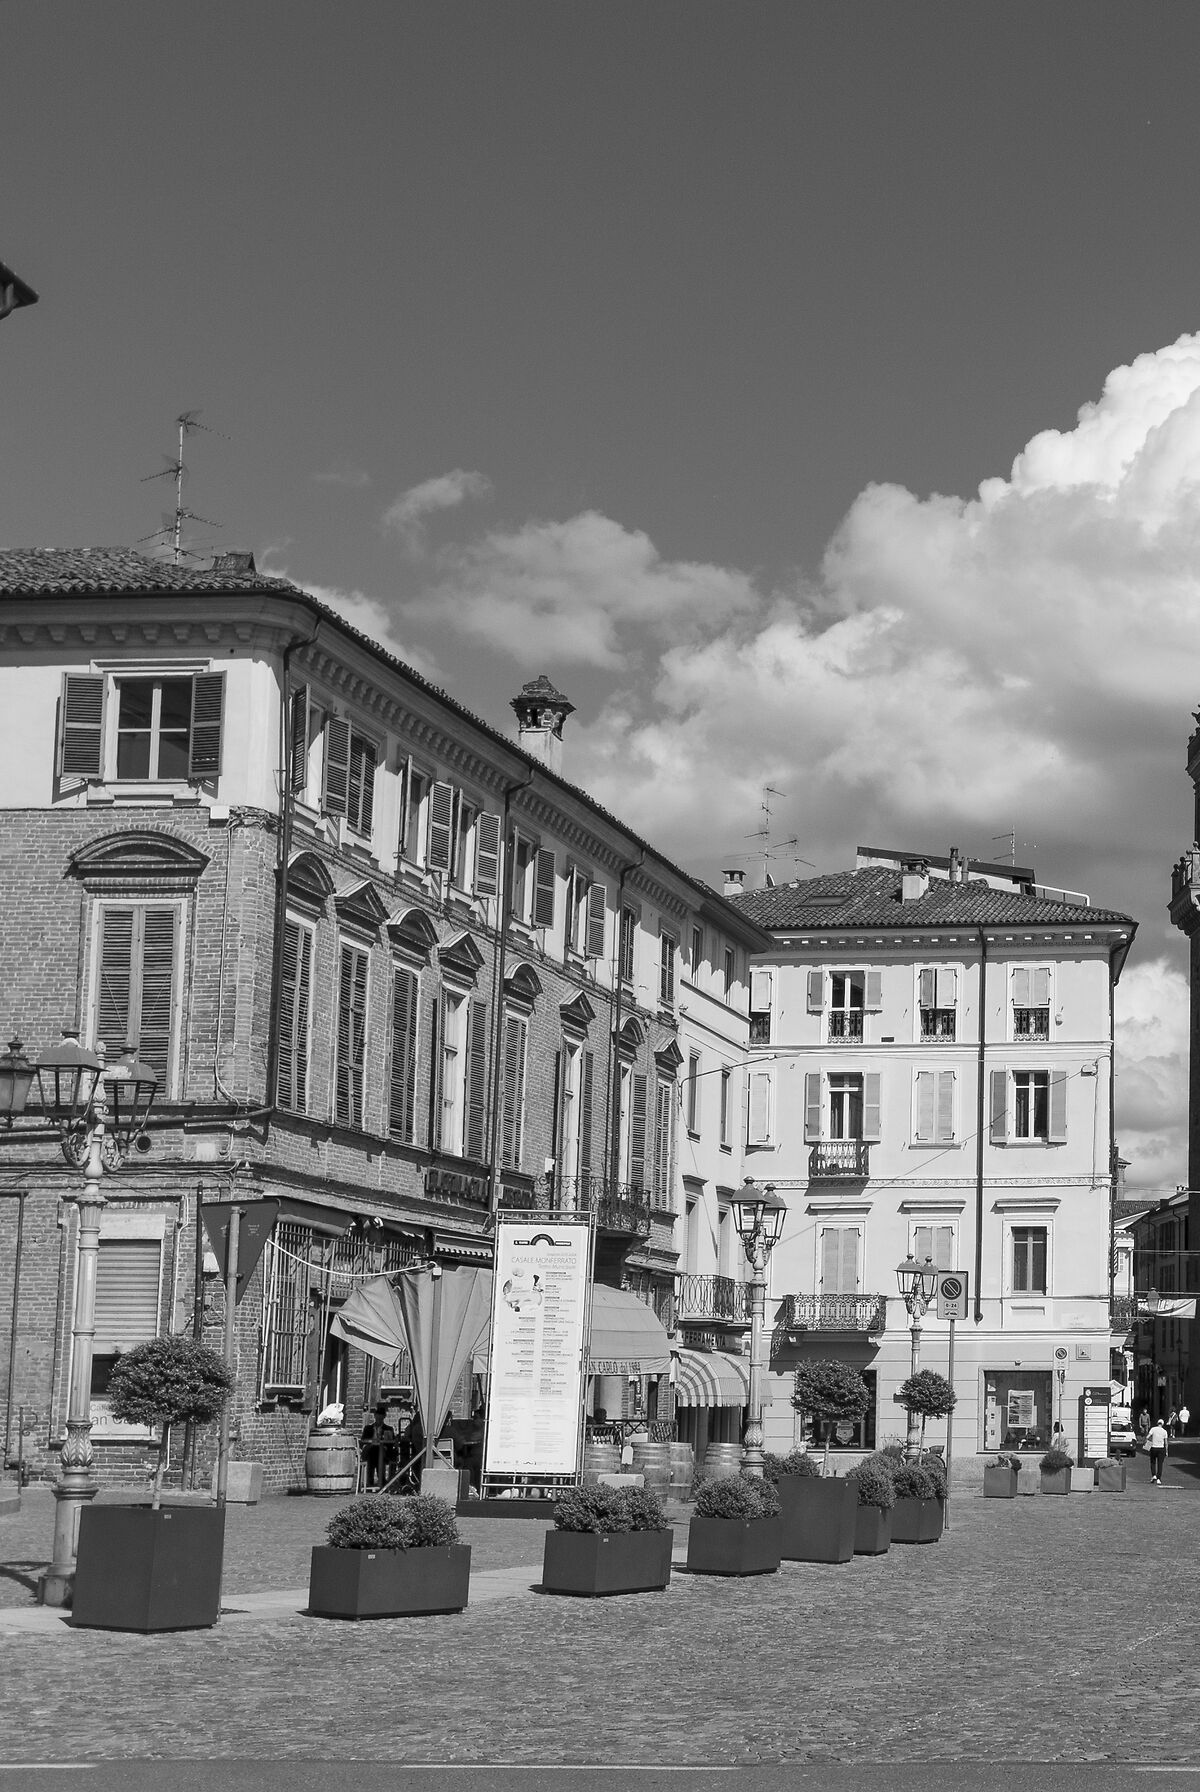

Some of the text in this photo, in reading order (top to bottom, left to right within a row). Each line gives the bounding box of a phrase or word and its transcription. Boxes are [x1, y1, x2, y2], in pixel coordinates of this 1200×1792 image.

[535, 1257, 577, 1265] MONFERRATO
[684, 1331, 726, 1347] FERRAMENTA
[598, 1361, 618, 1374] CARLO
[91, 1416, 107, 1425] an
